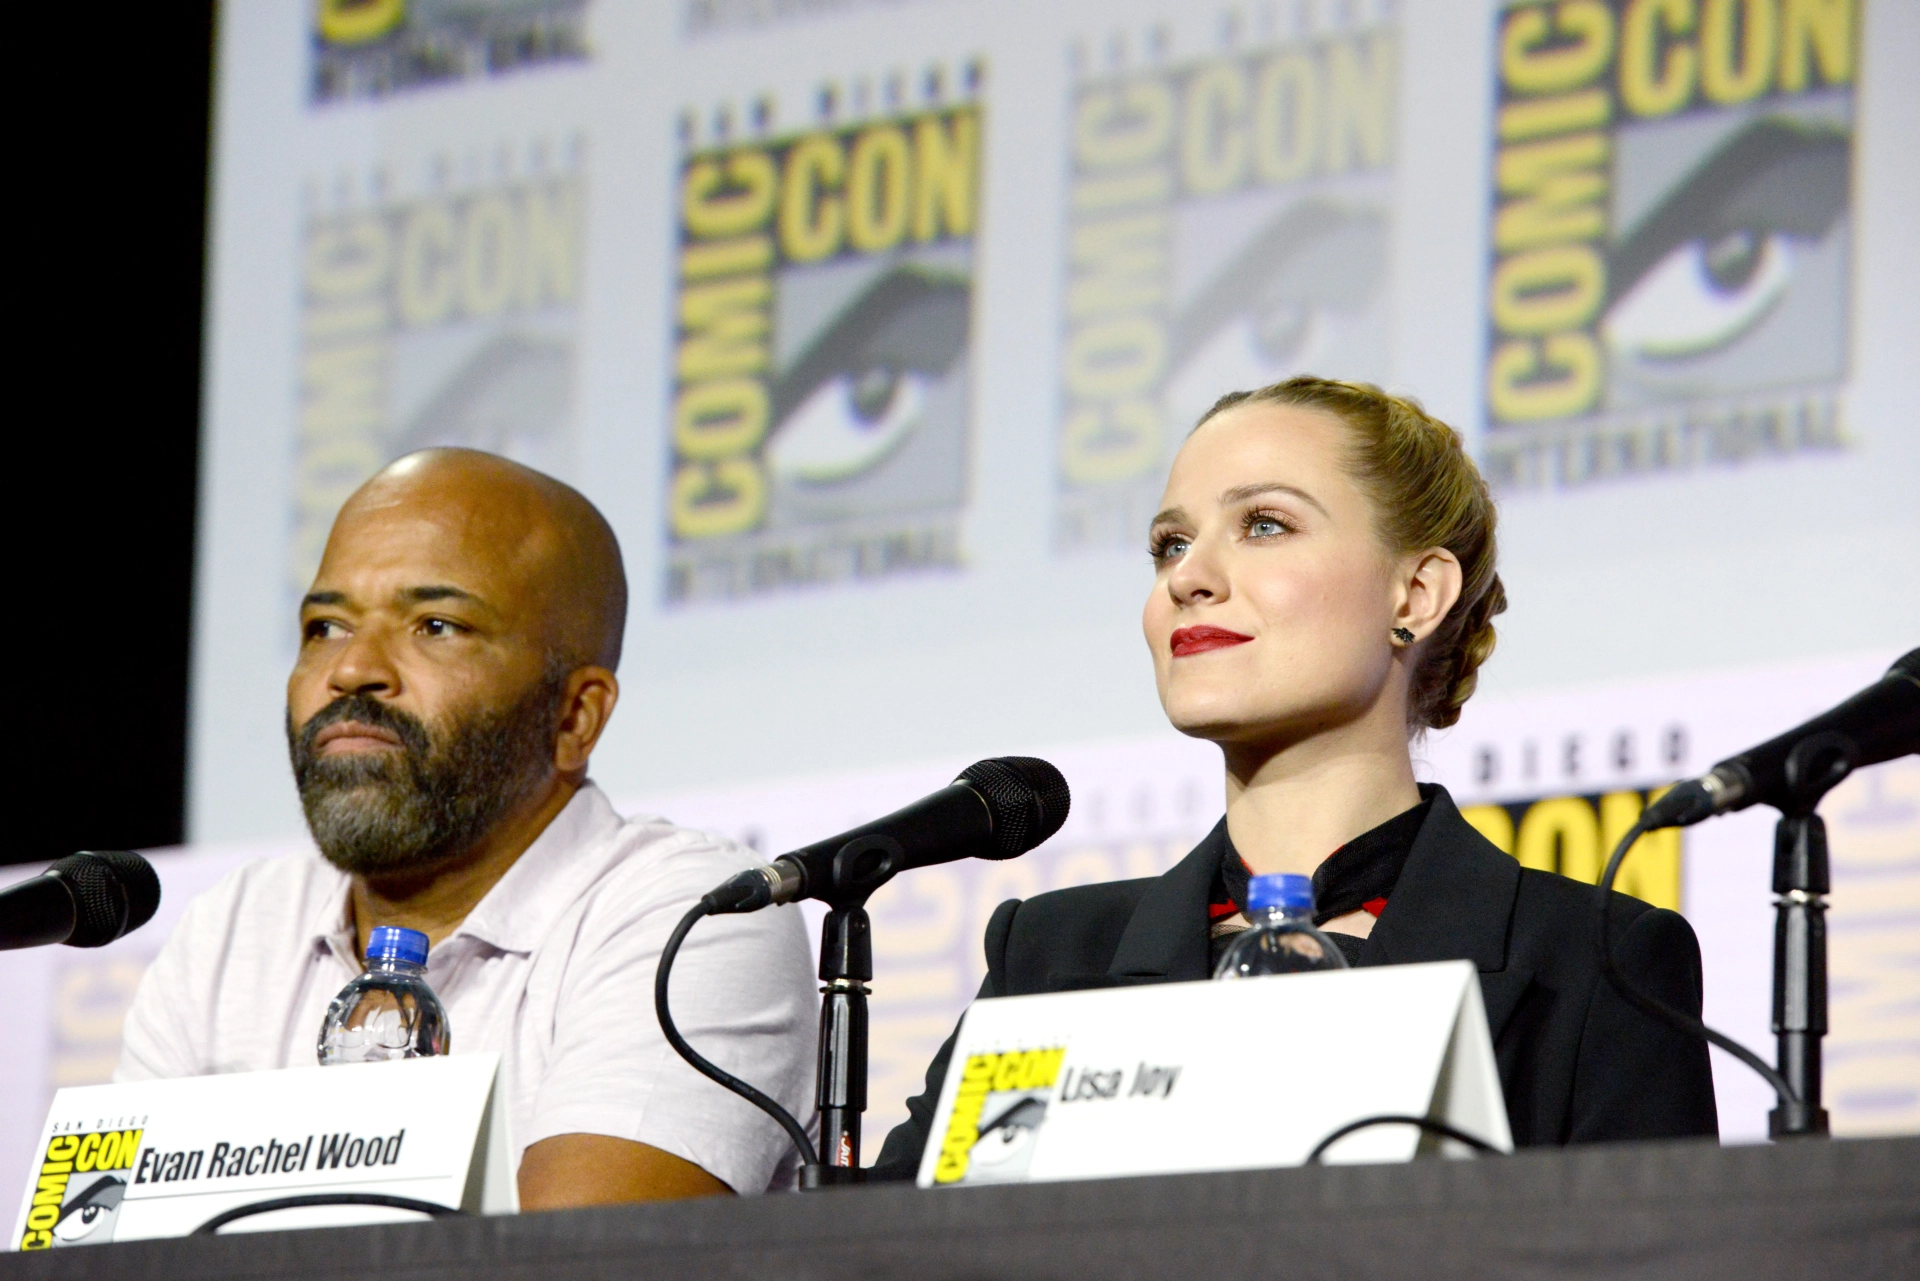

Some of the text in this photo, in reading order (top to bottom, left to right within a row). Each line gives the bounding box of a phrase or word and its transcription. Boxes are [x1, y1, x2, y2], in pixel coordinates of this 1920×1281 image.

[1621, 0, 1855, 117] CON
[1183, 47, 1393, 195] CON
[779, 113, 977, 262] CON
[1489, 2, 1614, 423] COMIC
[401, 197, 583, 319] CON
[1063, 83, 1172, 484] COMIC
[671, 153, 777, 540] COMIC
[52, 1114, 149, 1133] SAN DIEGO
[992, 1047, 1066, 1092] CON
[1060, 1061, 1182, 1102] Lisa Joy
[21, 1134, 80, 1251] COMIC
[75, 1129, 144, 1172] CON
[134, 1129, 406, 1184] Evan Rachel Wood
